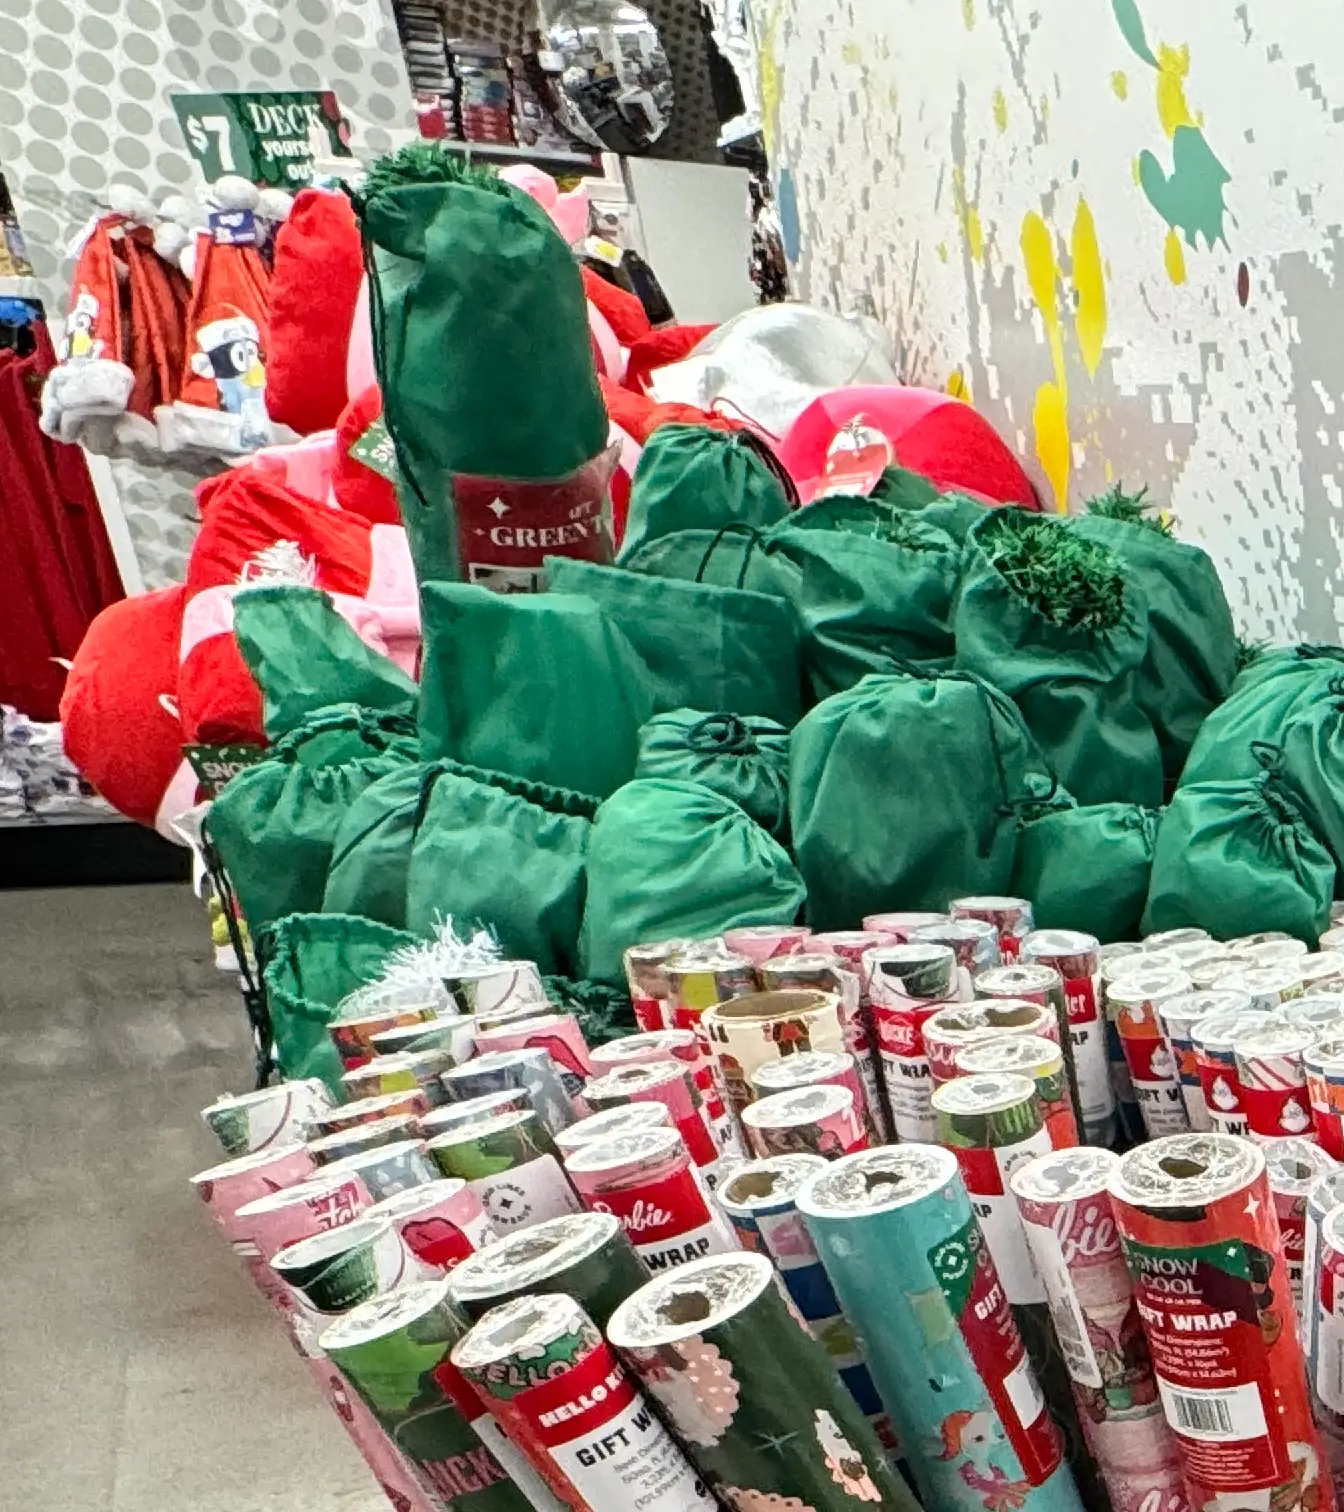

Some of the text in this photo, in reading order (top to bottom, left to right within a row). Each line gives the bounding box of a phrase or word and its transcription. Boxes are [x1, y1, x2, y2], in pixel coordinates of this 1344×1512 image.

[186, 114, 236, 172] $7
[642, 1237, 711, 1271] WRAP
[1052, 1199, 1122, 1264] bie
[1170, 1310, 1238, 1332] WRAP
[537, 1382, 608, 1429] HELLO
[574, 1426, 632, 1469] GIFT
